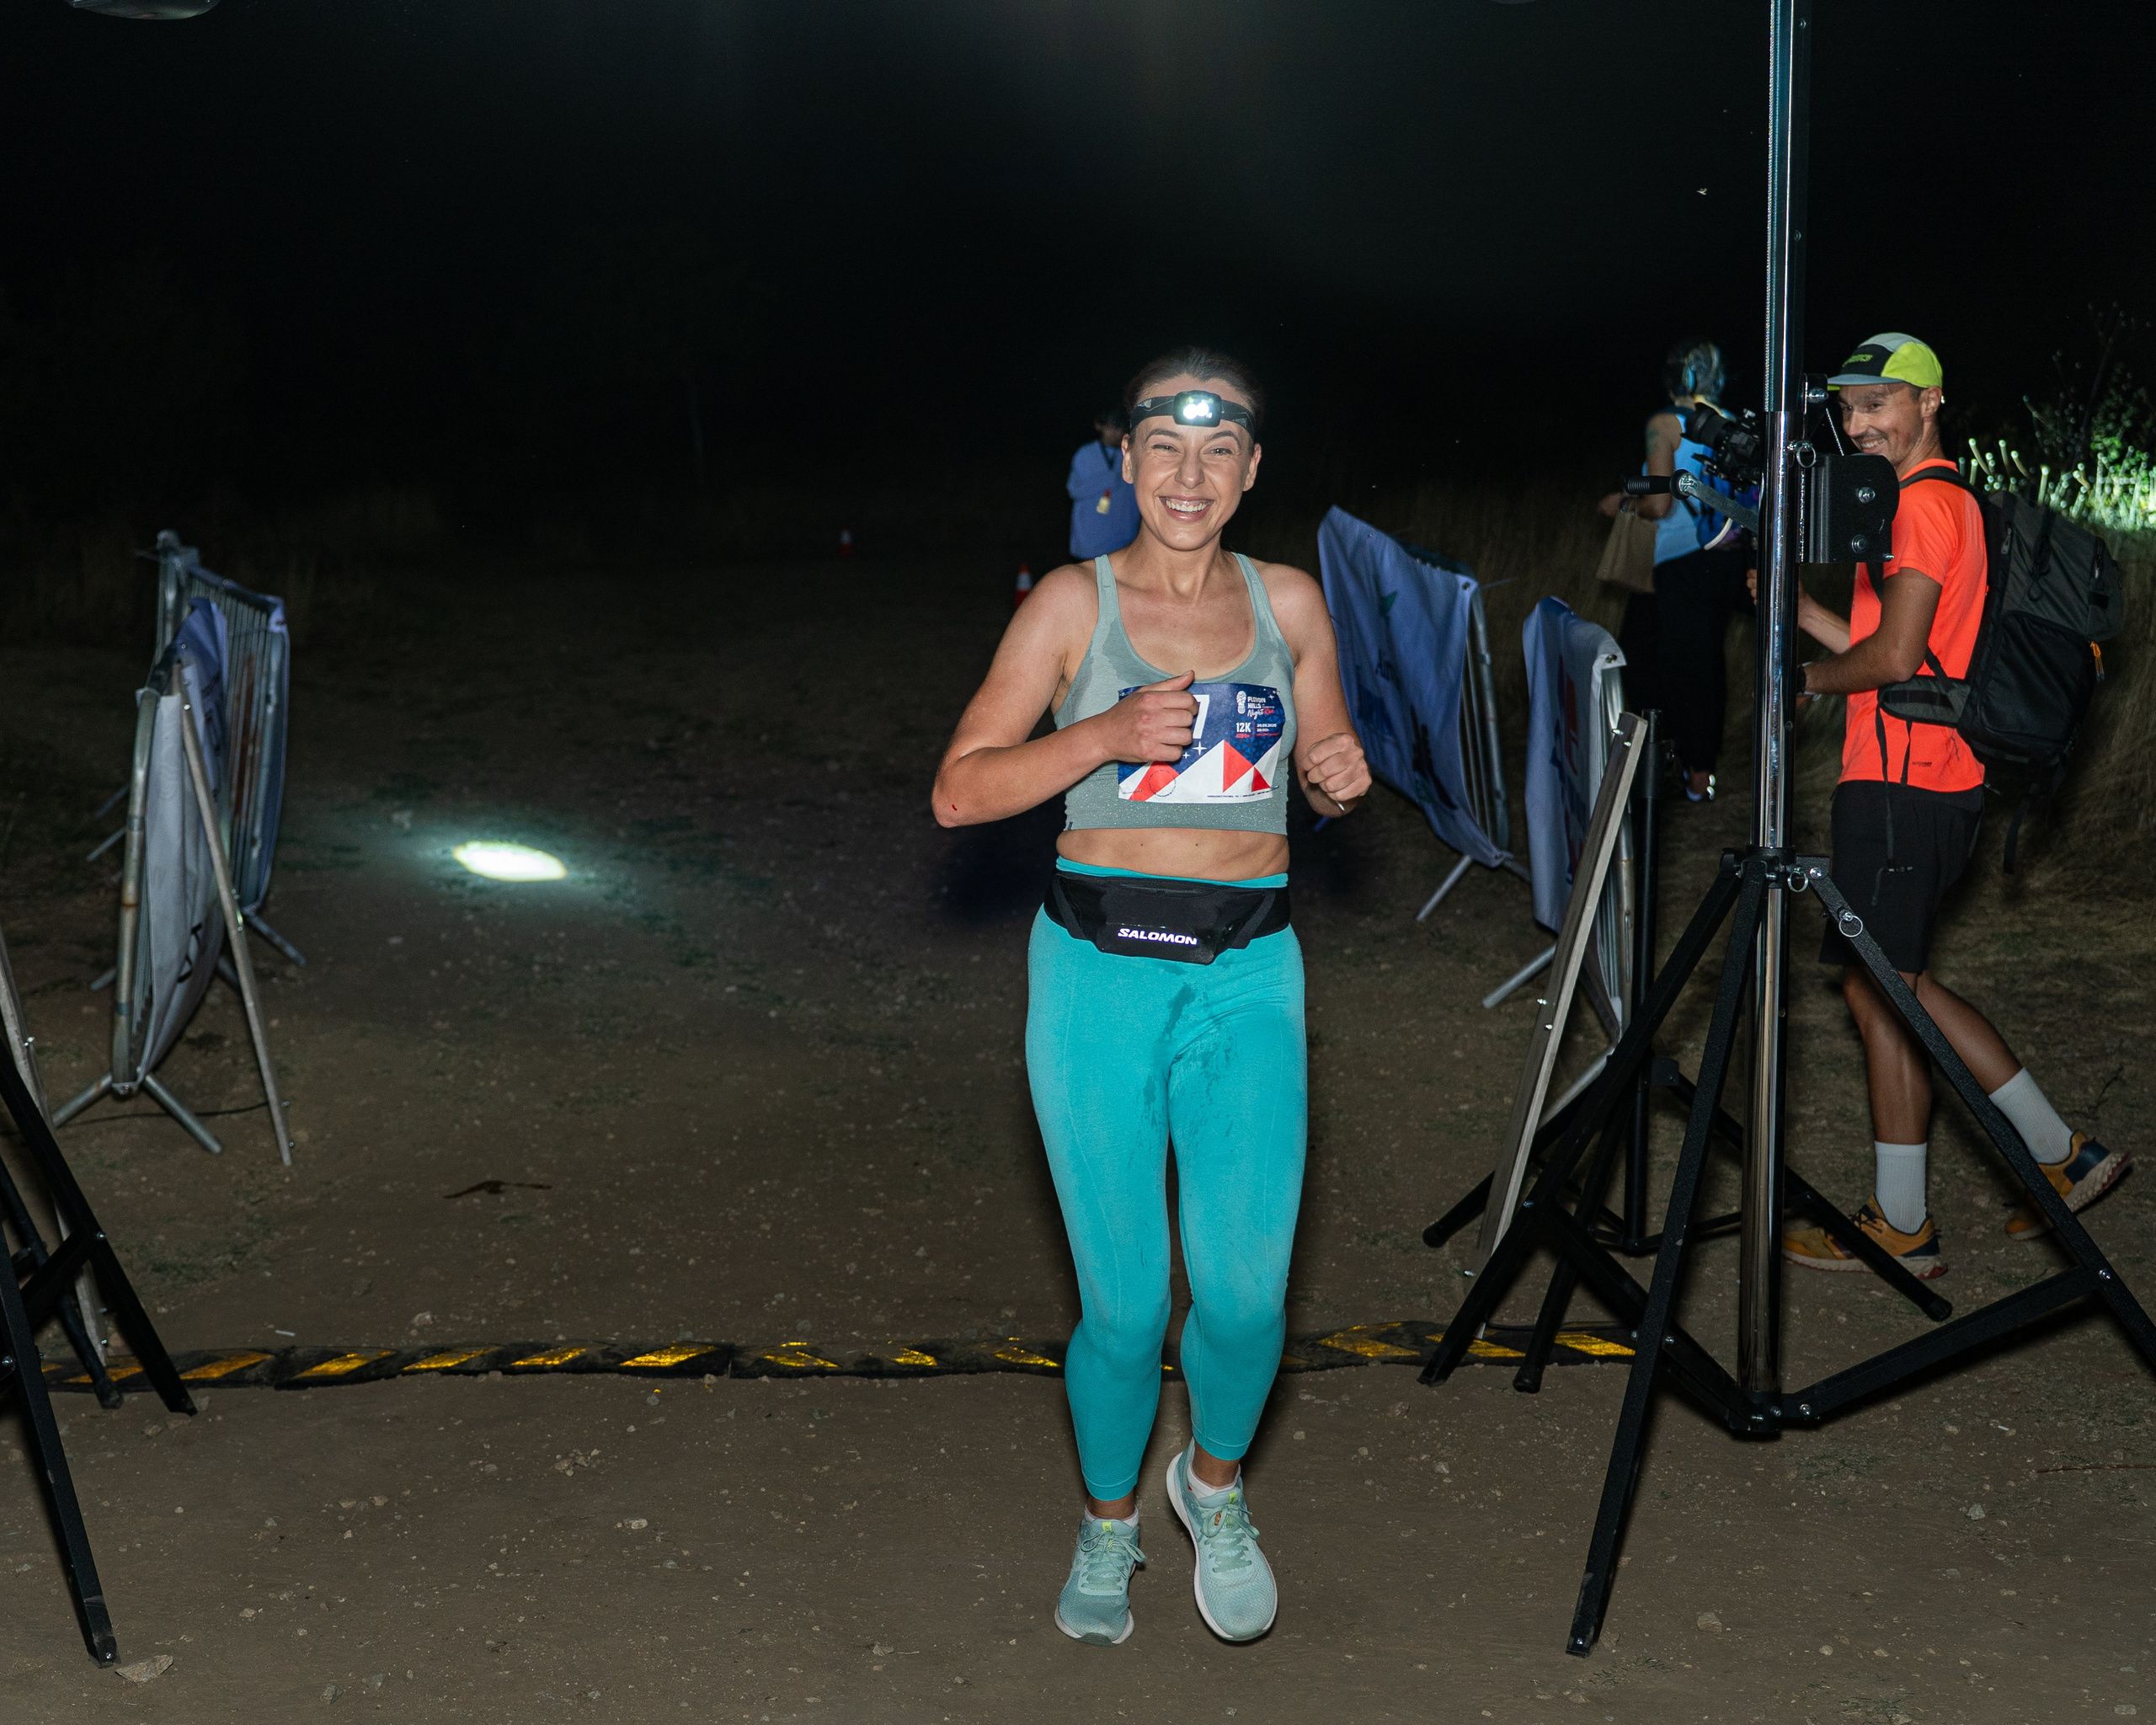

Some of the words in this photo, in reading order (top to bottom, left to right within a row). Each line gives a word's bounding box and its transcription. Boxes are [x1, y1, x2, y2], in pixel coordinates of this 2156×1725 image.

[1247, 708, 1264, 720] Night
[1235, 722, 1251, 733] 12K
[1118, 928, 1198, 945] SALOMON
